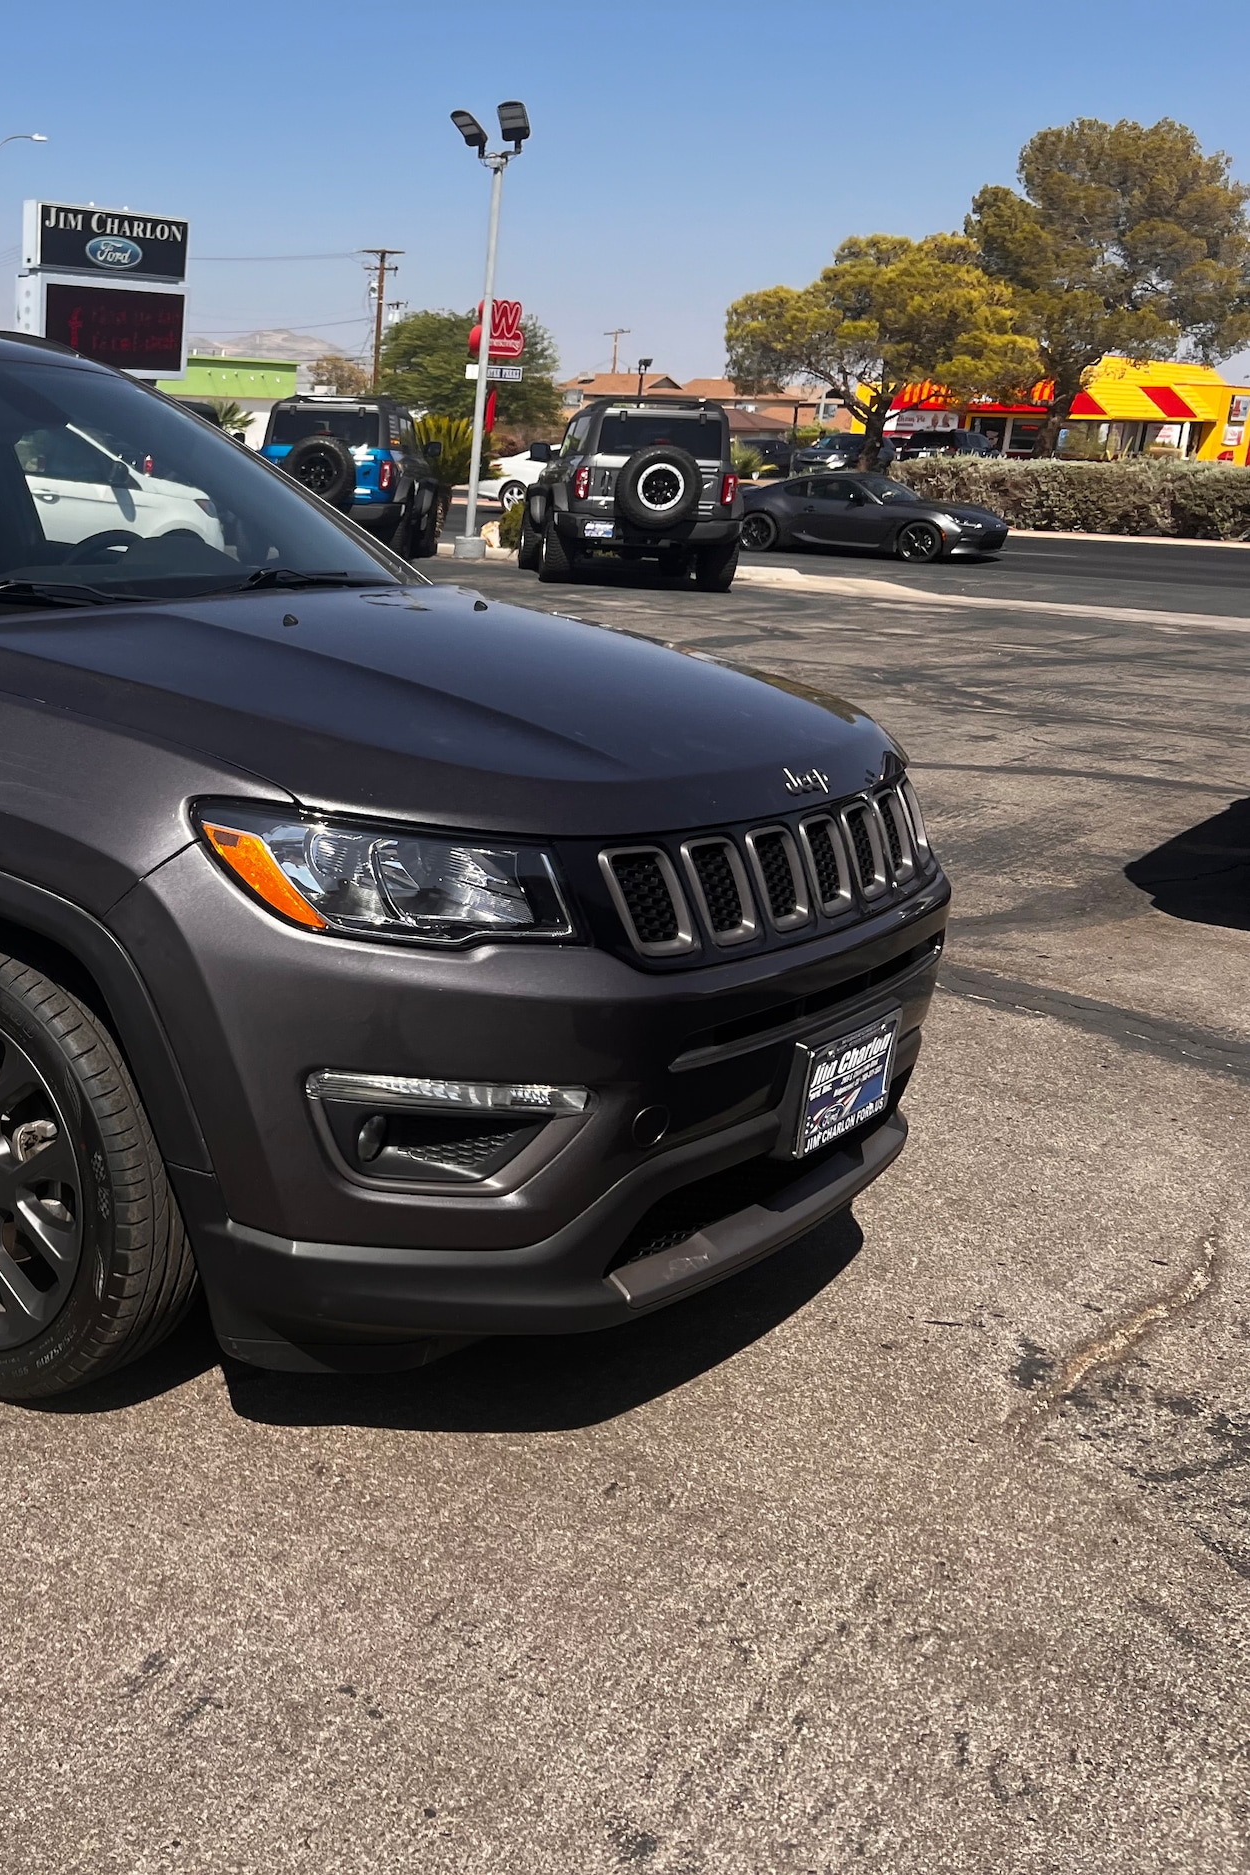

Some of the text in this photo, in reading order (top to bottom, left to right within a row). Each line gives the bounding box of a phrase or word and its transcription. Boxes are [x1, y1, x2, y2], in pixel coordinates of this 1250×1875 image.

[45, 207, 183, 242] JIM CHARLON
[96, 240, 132, 264] Ford
[783, 767, 829, 796] Jeep
[810, 1060, 838, 1088] Jim
[837, 1032, 892, 1074] Charlon
[804, 1132, 822, 1153] JIM
[821, 1114, 856, 1144] CHARLON
